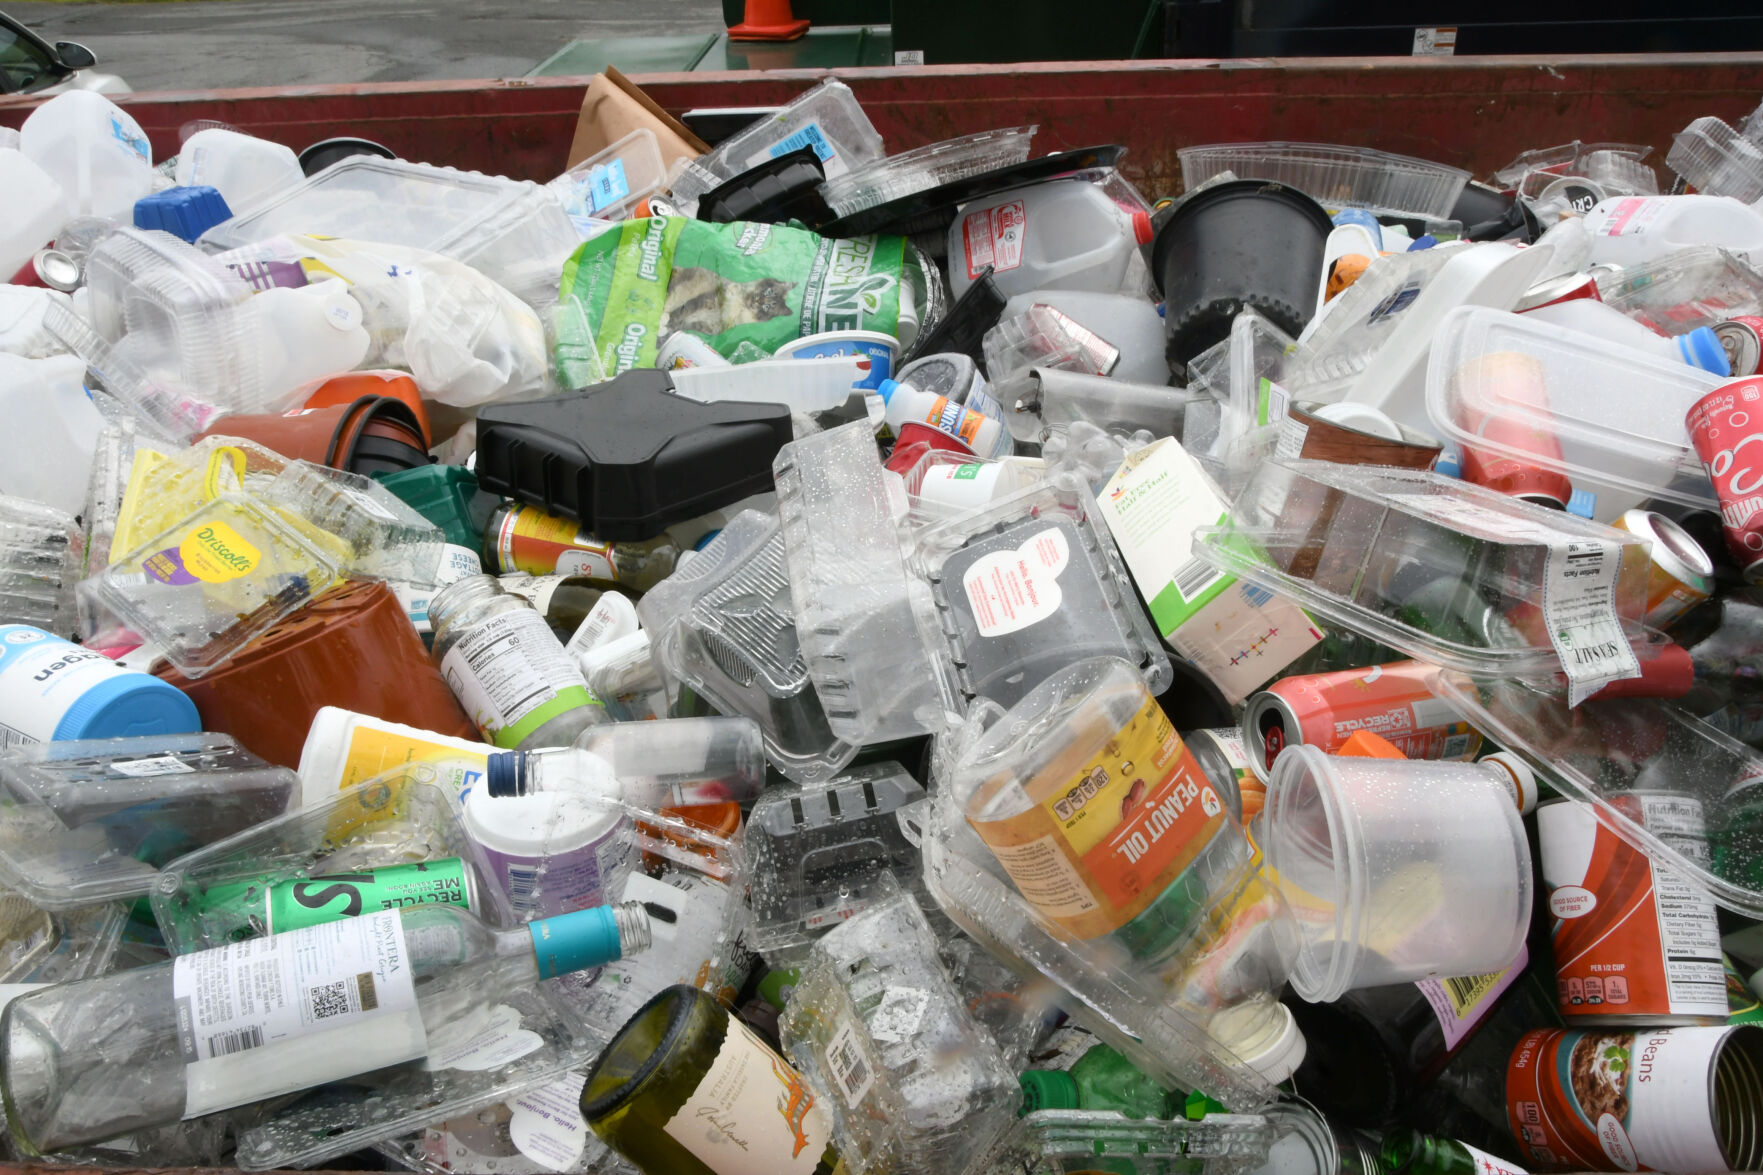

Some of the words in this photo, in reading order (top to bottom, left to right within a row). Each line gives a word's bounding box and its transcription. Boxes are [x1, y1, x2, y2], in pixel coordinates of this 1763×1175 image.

[637, 216, 668, 281] Original
[196, 526, 253, 573] Driscoll's
[1564, 570, 1578, 578] Facts
[1580, 568, 1600, 577] Nutrition
[1024, 579, 1040, 607] Bonjour.
[458, 626, 487, 650] Nutrition
[486, 616, 507, 631] Facts
[472, 652, 495, 672] Calories
[508, 635, 521, 647] 60
[1573, 647, 1599, 664] SALT
[1600, 640, 1618, 657] SEA
[1334, 715, 1389, 731] RECYCLE
[1094, 773, 1109, 787] 120
[1146, 773, 1200, 844] PEANUT
[1117, 833, 1149, 865] OIL
[432, 876, 460, 891] ME
[381, 889, 463, 910] RECYCLE
[1081, 901, 1093, 910] TIPS
[1566, 896, 1588, 904] SOURCE
[381, 916, 400, 974] FRONTERA
[1515, 1048, 1532, 1068] 454g
[1638, 1039, 1667, 1082] Beans
[709, 1056, 737, 1099] AUSTRALIA
[516, 1099, 551, 1119] Bonjour.
[1526, 1103, 1539, 1124] 100
[553, 1115, 577, 1132] Hello.
